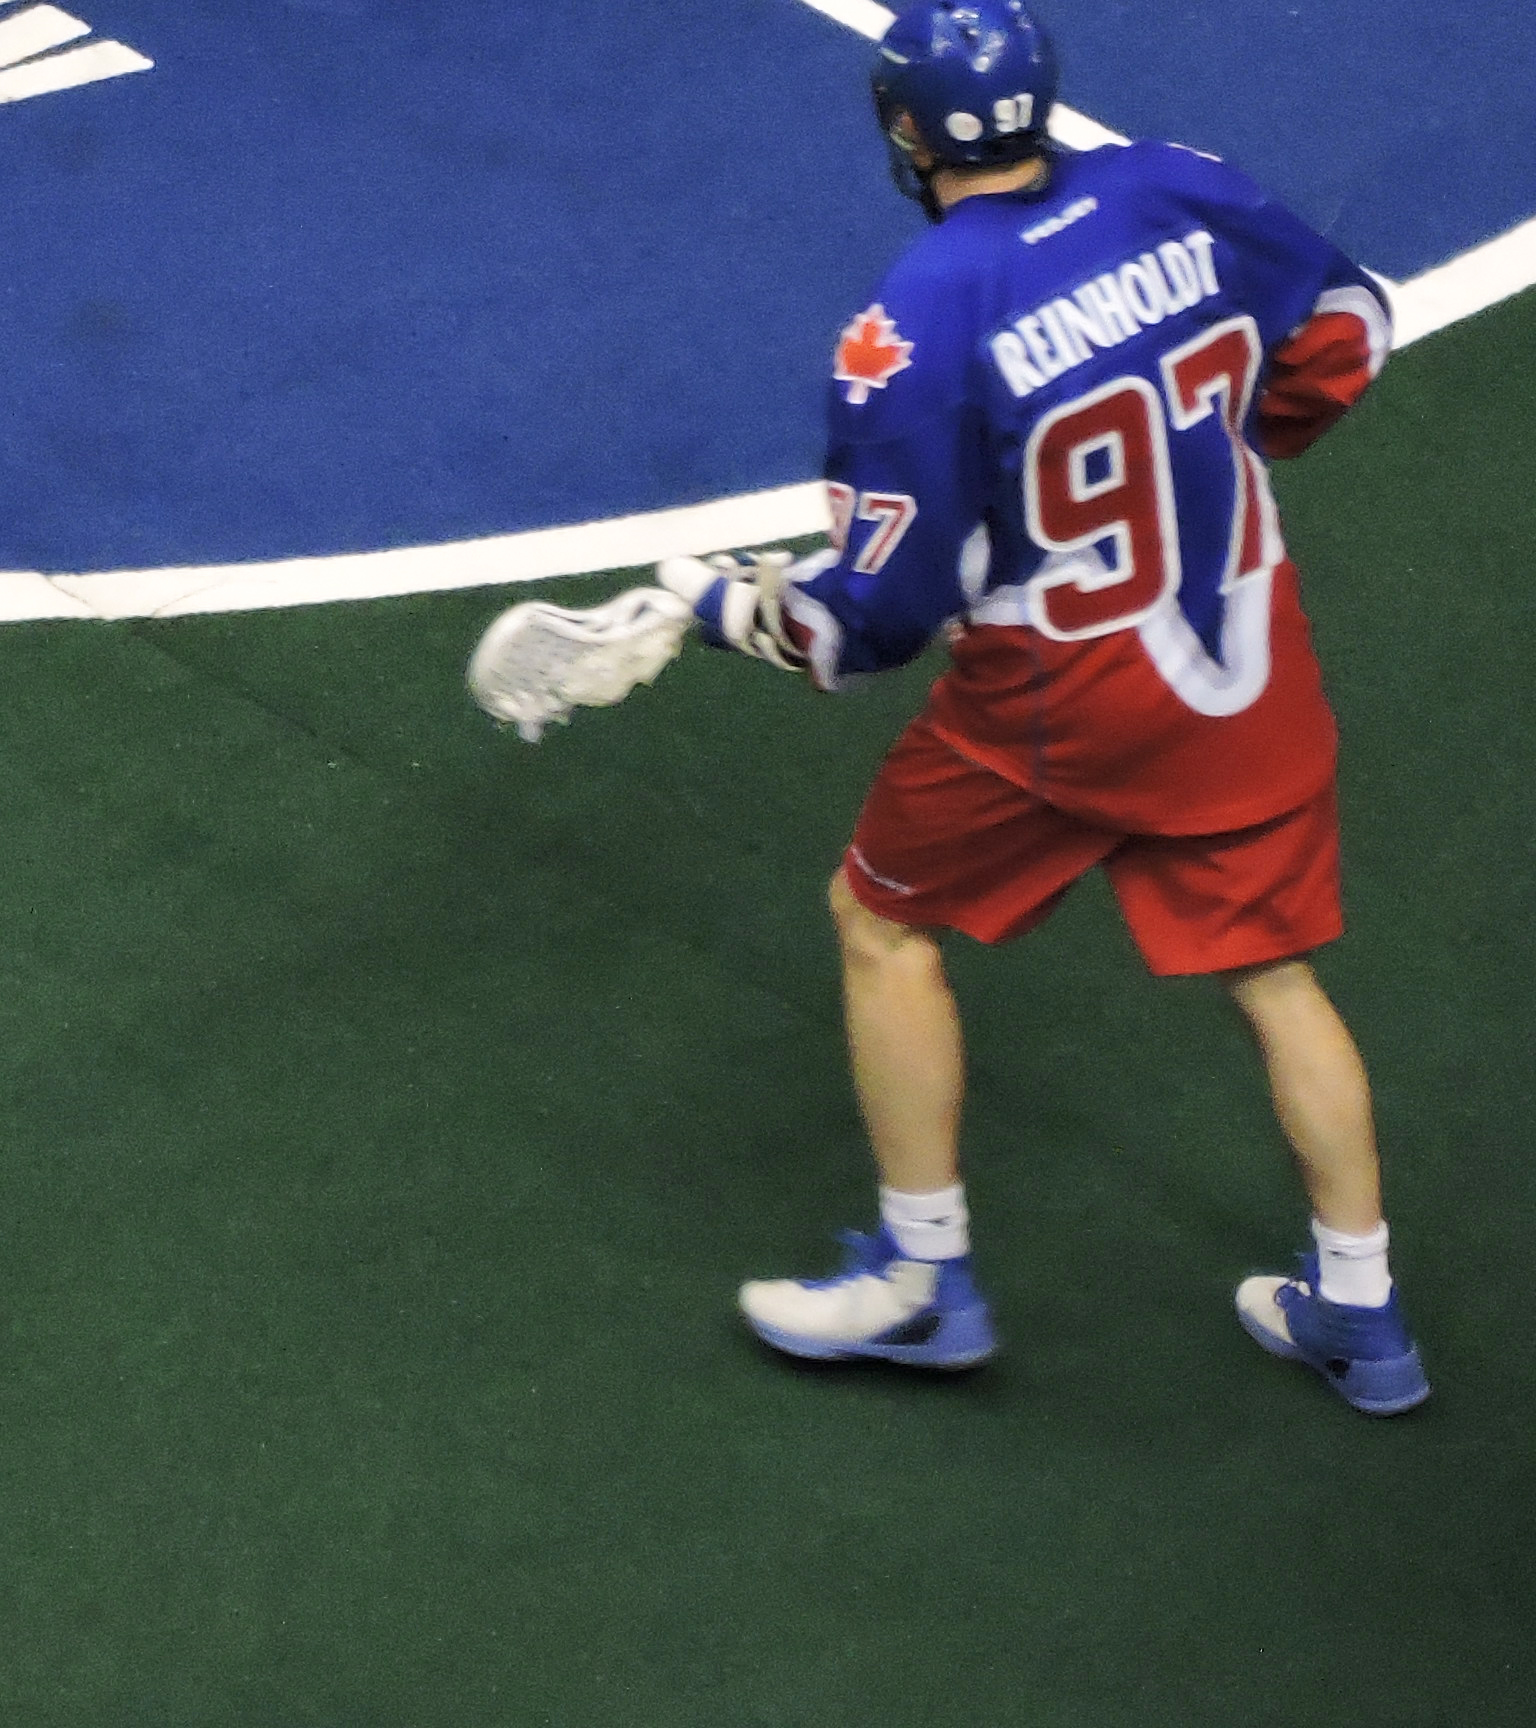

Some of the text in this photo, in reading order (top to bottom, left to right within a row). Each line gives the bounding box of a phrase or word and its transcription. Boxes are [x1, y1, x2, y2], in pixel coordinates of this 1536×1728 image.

[992, 92, 1034, 133] 97
[990, 229, 1221, 398] REINHOLDT
[1023, 314, 1278, 642] 97
